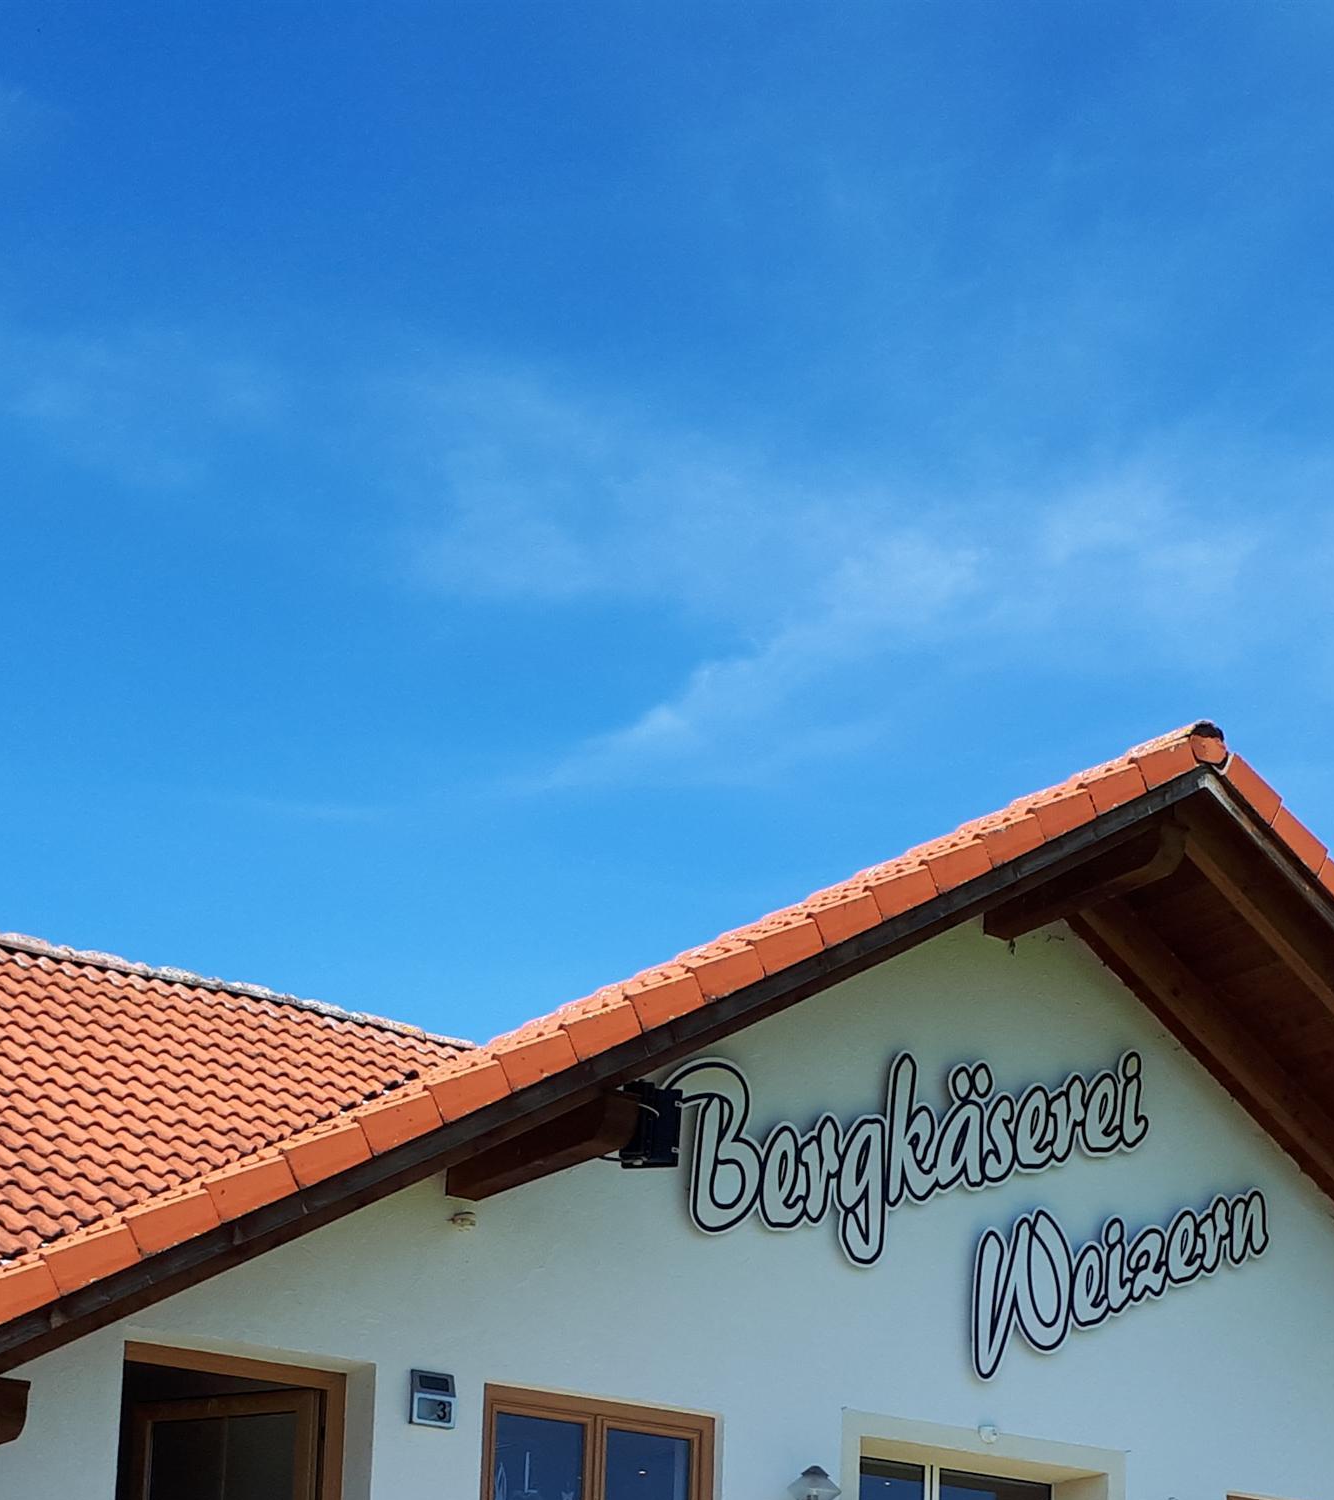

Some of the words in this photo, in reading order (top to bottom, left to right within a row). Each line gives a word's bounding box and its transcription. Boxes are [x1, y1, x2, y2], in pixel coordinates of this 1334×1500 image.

[664, 1049, 1149, 1268] Bergkäserei
[971, 1187, 1272, 1382] Weizern
[435, 1401, 447, 1421] 3
